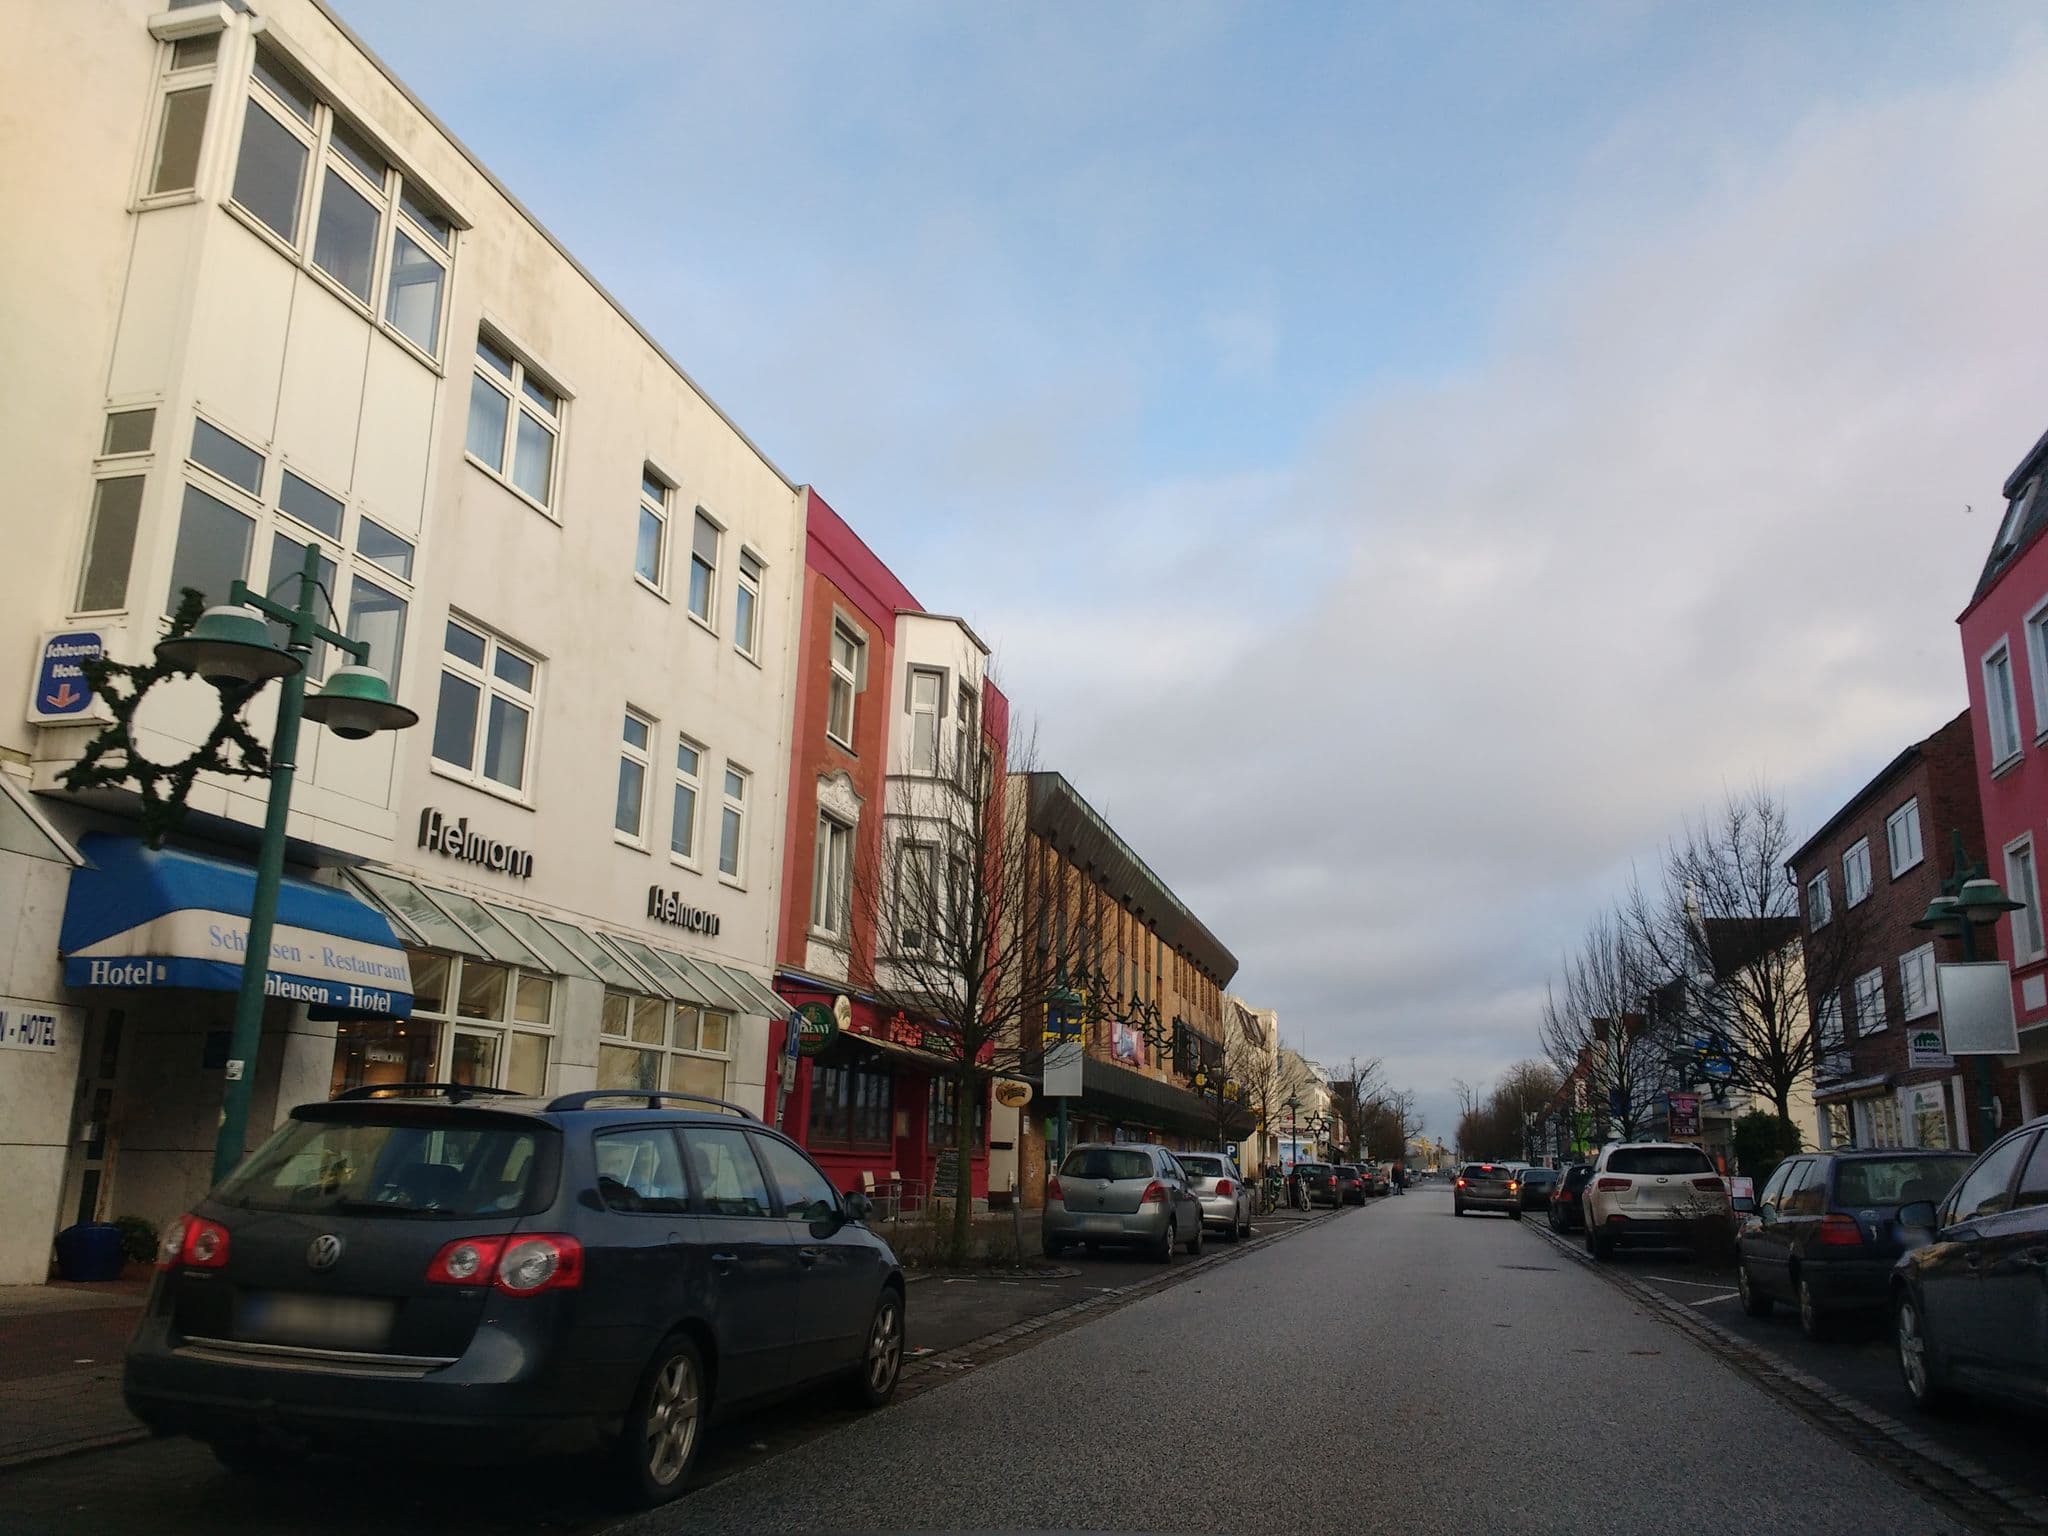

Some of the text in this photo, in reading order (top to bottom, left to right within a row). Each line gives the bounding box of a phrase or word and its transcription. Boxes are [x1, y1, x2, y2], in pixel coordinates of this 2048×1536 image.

[209, 925, 301, 962] Schsen
[321, 946, 408, 981] Restaurant
[90, 960, 153, 985] Hotel
[264, 973, 329, 1004] hleusen
[348, 985, 392, 1013] Hotel
[17, 1013, 57, 1046] HOTEL
[1227, 1145, 1236, 1155] P
